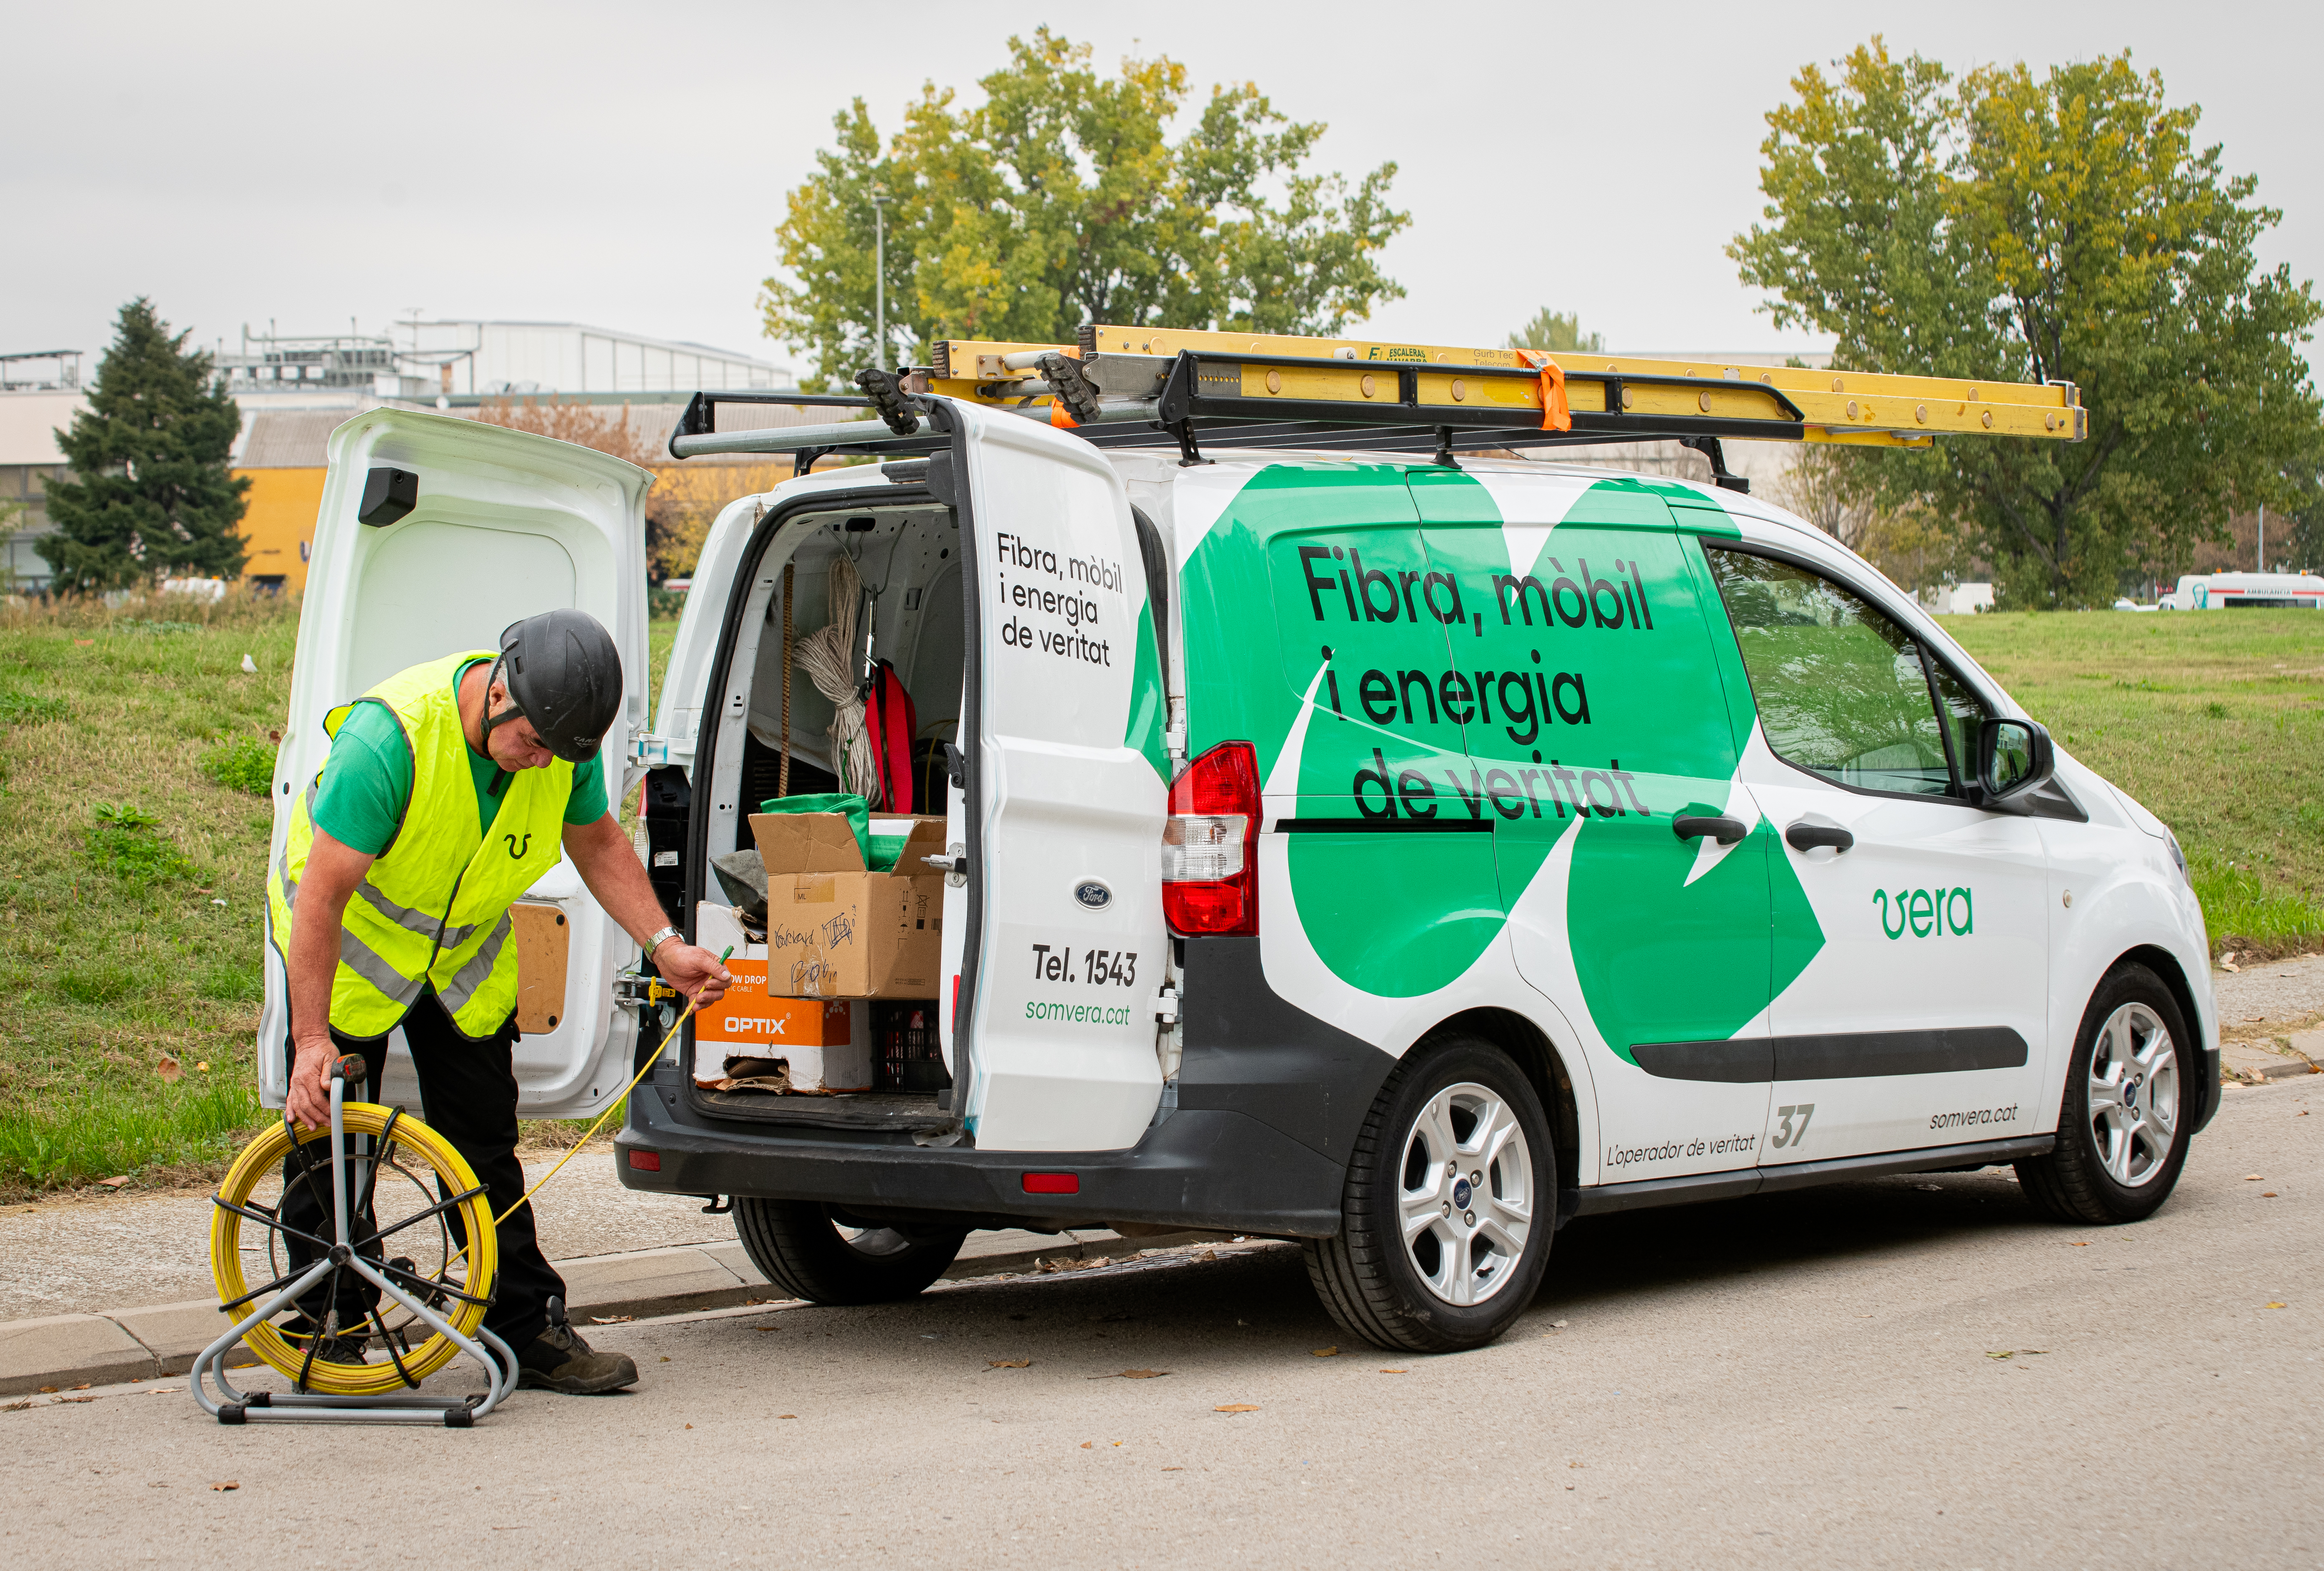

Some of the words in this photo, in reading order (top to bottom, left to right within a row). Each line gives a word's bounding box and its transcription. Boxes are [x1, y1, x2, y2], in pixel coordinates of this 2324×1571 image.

[1389, 348, 1426, 358] ESCALERAS
[1473, 349, 1494, 358] Gurb
[1498, 351, 1513, 359] Tec
[1474, 359, 1510, 367] Telecom
[997, 532, 1063, 581] Fibra,
[1069, 556, 1123, 594] mòbil
[999, 572, 1005, 603] i
[1012, 584, 1098, 626] energia
[1298, 545, 1482, 637] Fibra,
[1491, 557, 1654, 630] mòbil
[1002, 615, 1033, 649] de
[1038, 628, 1110, 667] veritat
[1321, 644, 1348, 721] i
[1359, 649, 1591, 746] energia
[1353, 747, 1438, 819] de
[1445, 749, 1650, 820] veritat
[1080, 884, 1106, 904] Ford
[1872, 887, 1973, 940] vera
[731, 974, 743, 983] OW
[745, 975, 767, 985] DROP
[1032, 943, 1075, 983] Tel.
[1085, 949, 1138, 987] 1543
[1025, 1001, 1130, 1026] somvera.cat
[1772, 1103, 1815, 1149] 37
[1929, 1102, 2018, 1129] somvera.cat
[1607, 1140, 1684, 1169] L'operador
[1687, 1137, 1705, 1157] de
[1710, 1134, 1755, 1154] veritat
